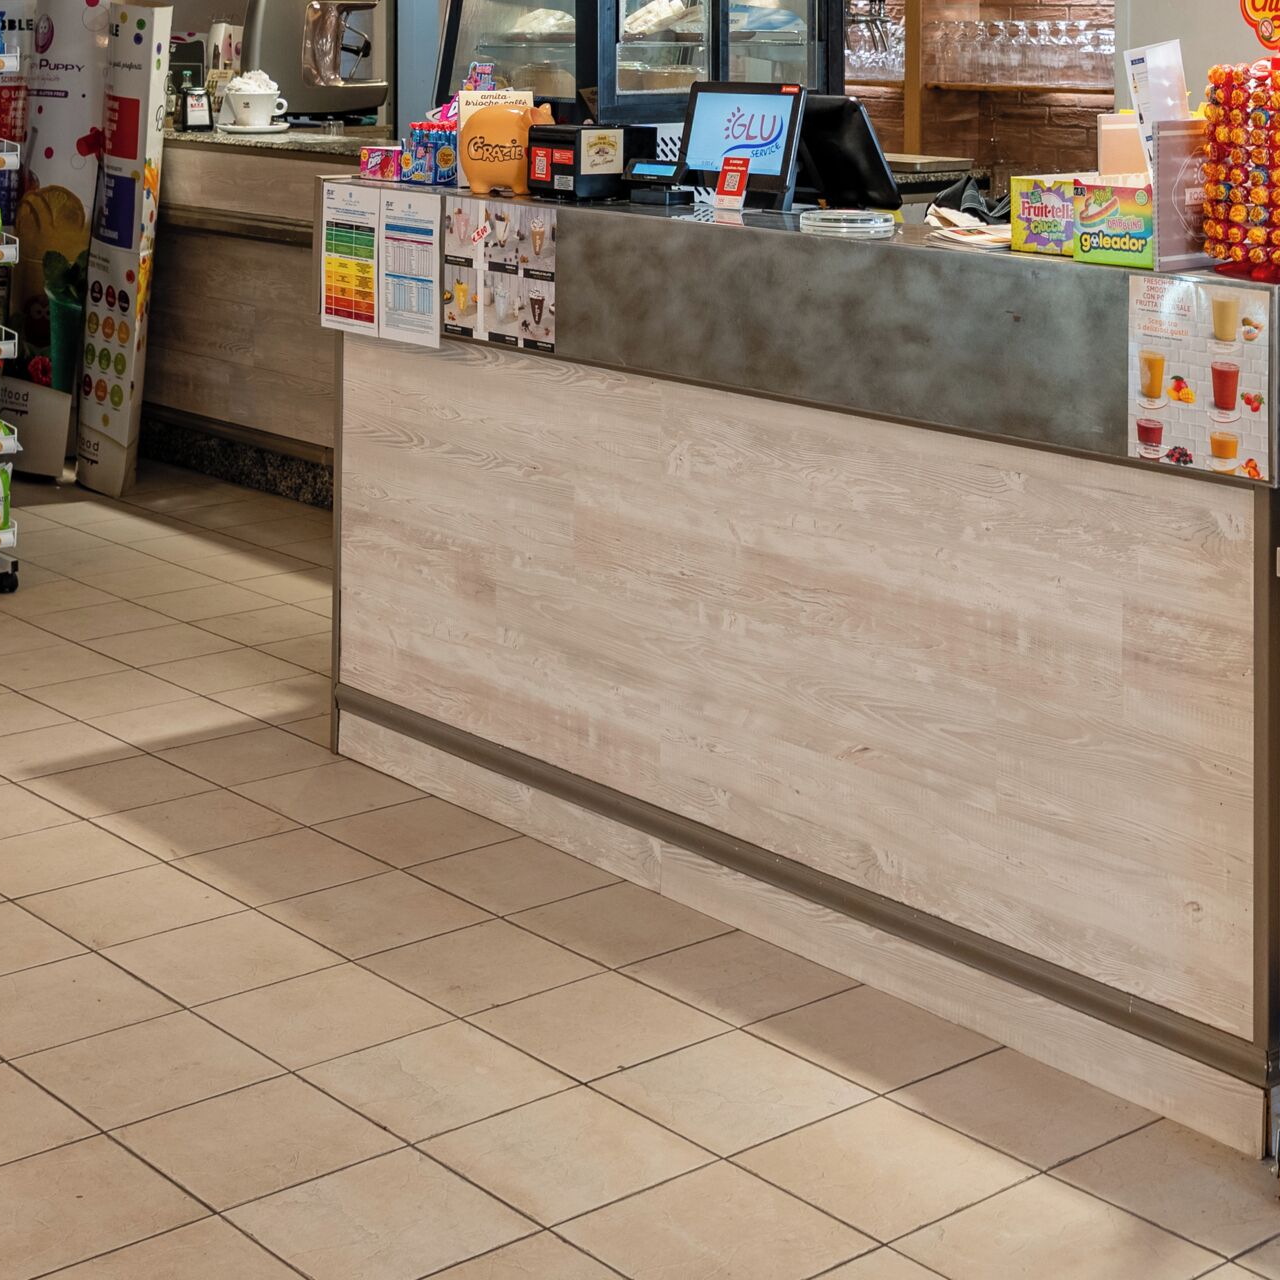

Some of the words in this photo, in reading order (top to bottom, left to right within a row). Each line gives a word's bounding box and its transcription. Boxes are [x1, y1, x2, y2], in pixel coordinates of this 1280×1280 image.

[731, 113, 777, 141] GLU
[750, 143, 781, 158] SERVICE
[1080, 231, 1147, 252] goleador
